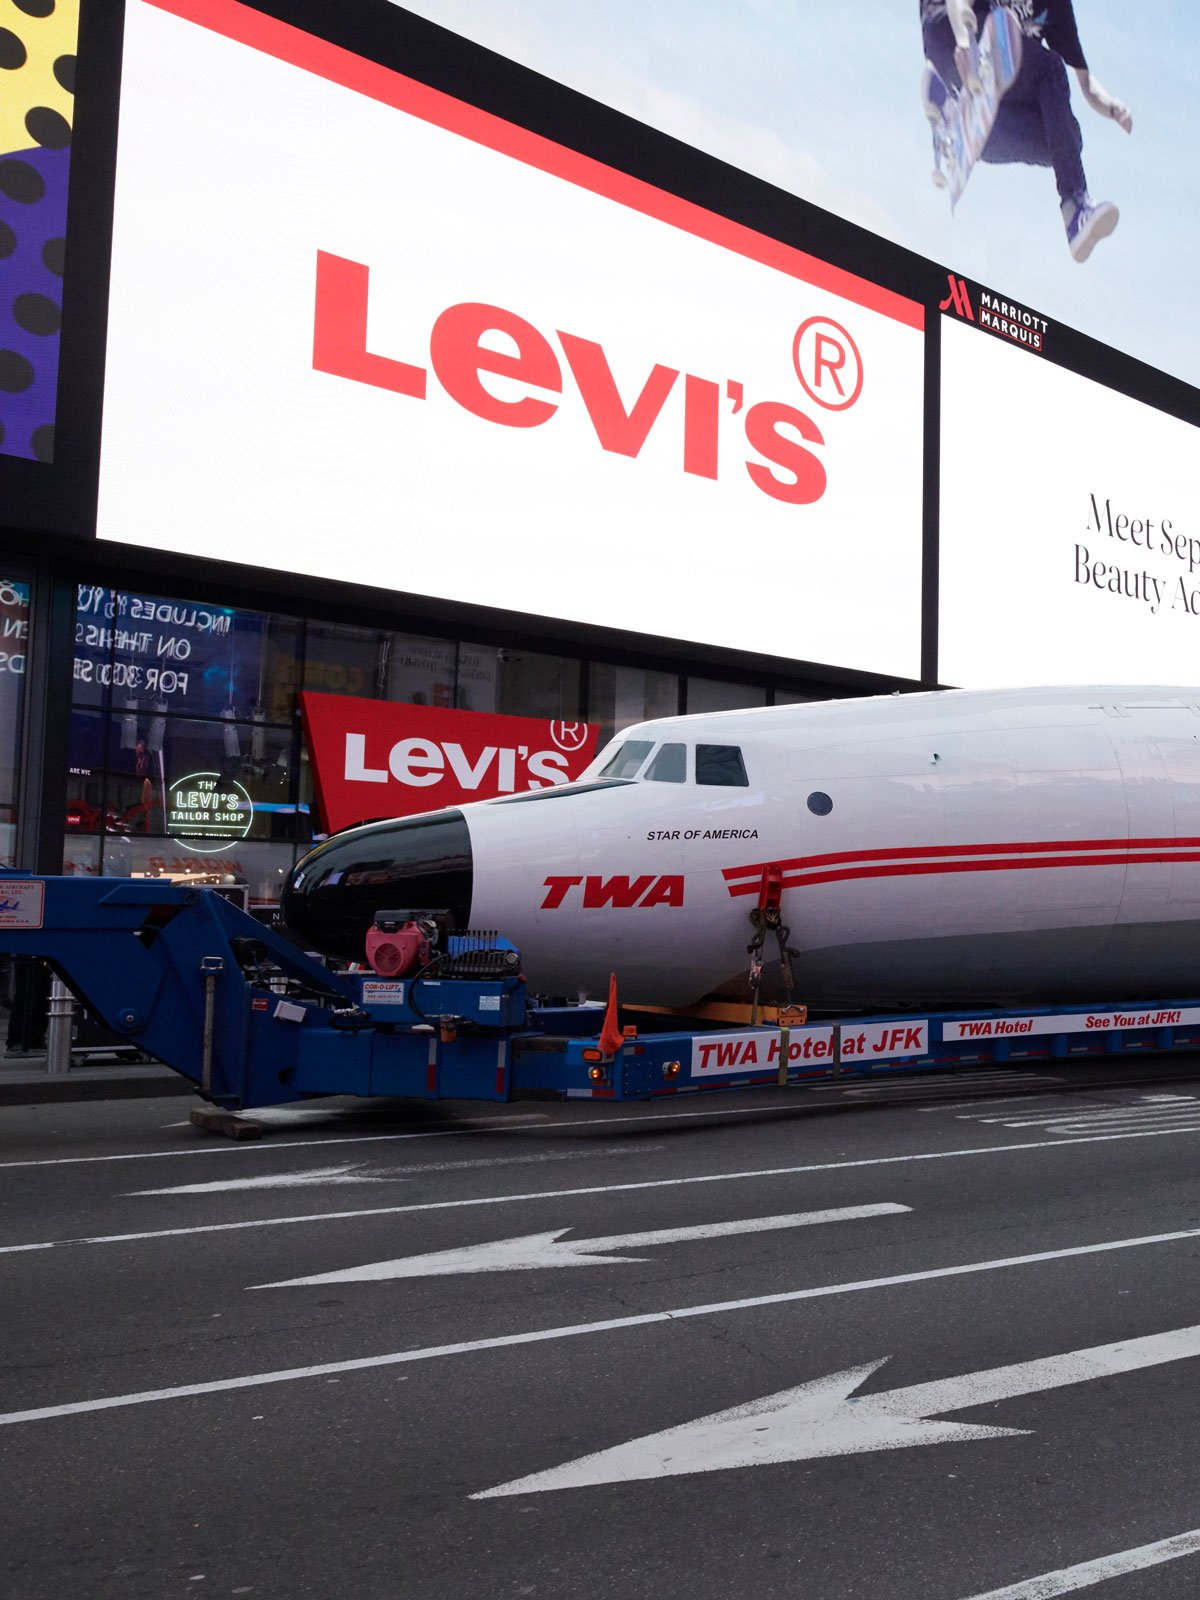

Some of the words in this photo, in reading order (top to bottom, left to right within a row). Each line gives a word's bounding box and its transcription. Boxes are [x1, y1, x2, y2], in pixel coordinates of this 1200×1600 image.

[981, 292, 1049, 334] MARRIOTT
[981, 310, 1041, 348] MARQUIS
[312, 248, 828, 505] Levi's
[1086, 492, 1155, 551] Meet
[1074, 543, 1168, 615] Beauty
[344, 732, 570, 793] Levi's
[176, 791, 239, 810] LEVI'S
[197, 781, 217, 790] TH
[171, 811, 210, 821] TAILOR
[214, 812, 244, 822] SHOP
[646, 830, 681, 841] STAR
[683, 830, 701, 840] OF
[702, 829, 759, 839] AMERICA
[540, 875, 685, 909] TWA
[958, 1021, 994, 1038] TWA
[994, 1019, 1033, 1036] Hotel
[1085, 1015, 1111, 1029] See
[1113, 1013, 1136, 1027] You
[1137, 1013, 1151, 1026] at
[1152, 1010, 1181, 1025] JFK!
[698, 1040, 758, 1069] TWA
[767, 1033, 834, 1063] Hotel
[841, 1032, 867, 1055] at
[873, 1027, 923, 1053] JFK
